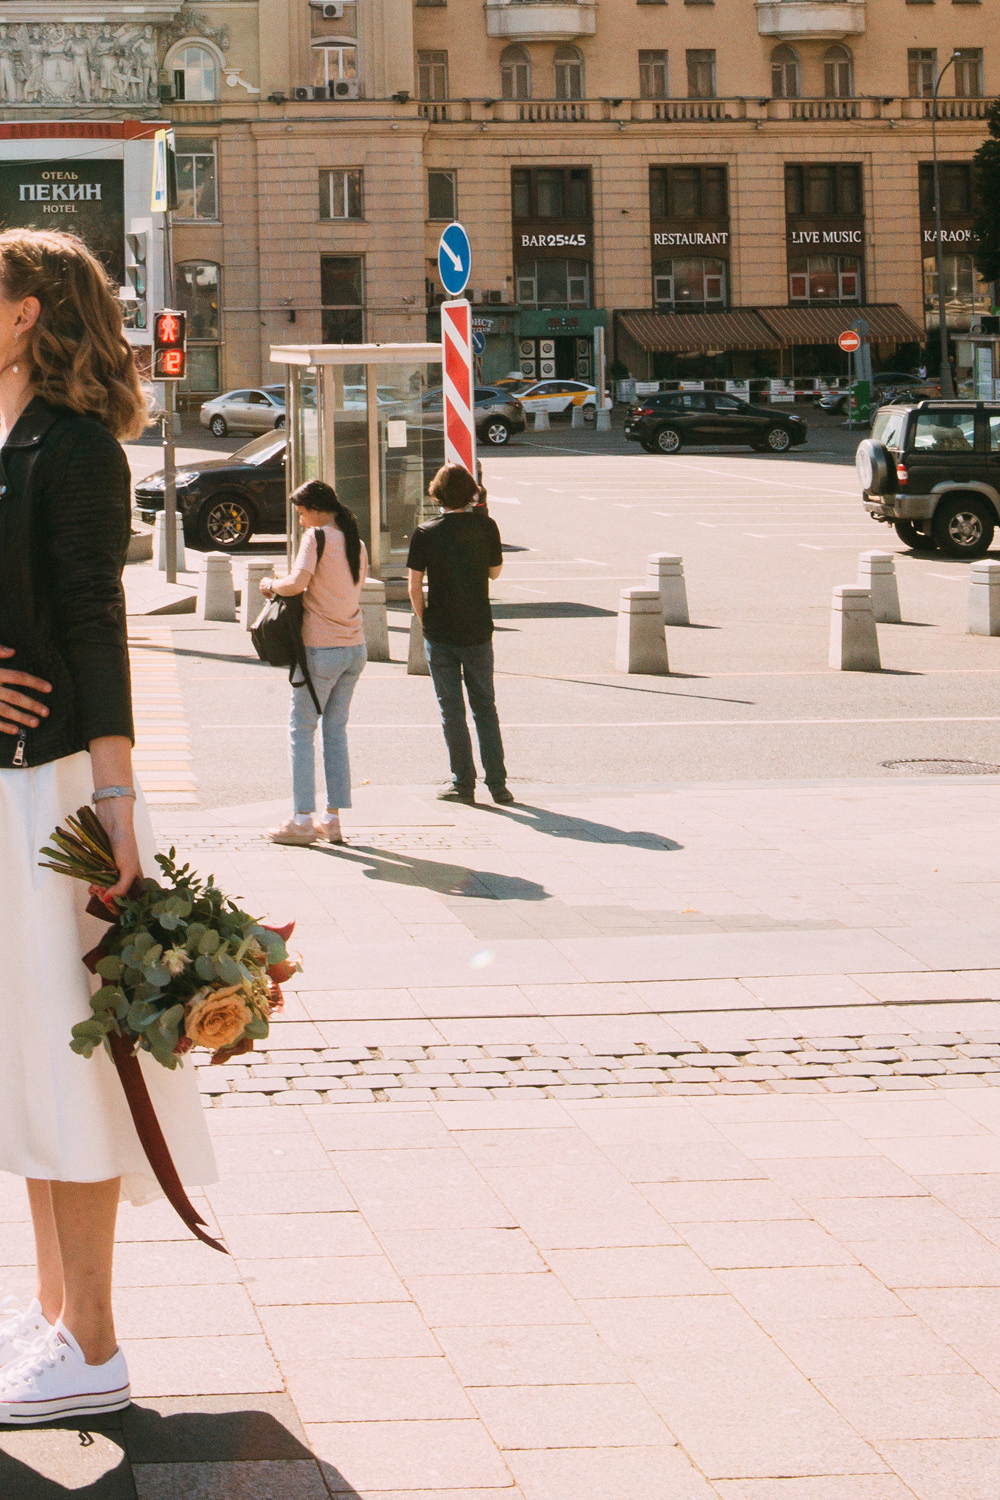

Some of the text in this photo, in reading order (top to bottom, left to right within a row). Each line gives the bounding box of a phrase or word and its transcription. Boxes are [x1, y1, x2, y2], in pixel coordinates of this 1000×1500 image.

[42, 171, 78, 180] ОТЕЛЬ
[19, 184, 102, 201] ПЕКИН
[43, 204, 78, 213] HOTEL
[521, 234, 587, 247] BAR25:45
[653, 232, 729, 246] RESTAURANT
[792, 230, 862, 244] LIVE MUSIC
